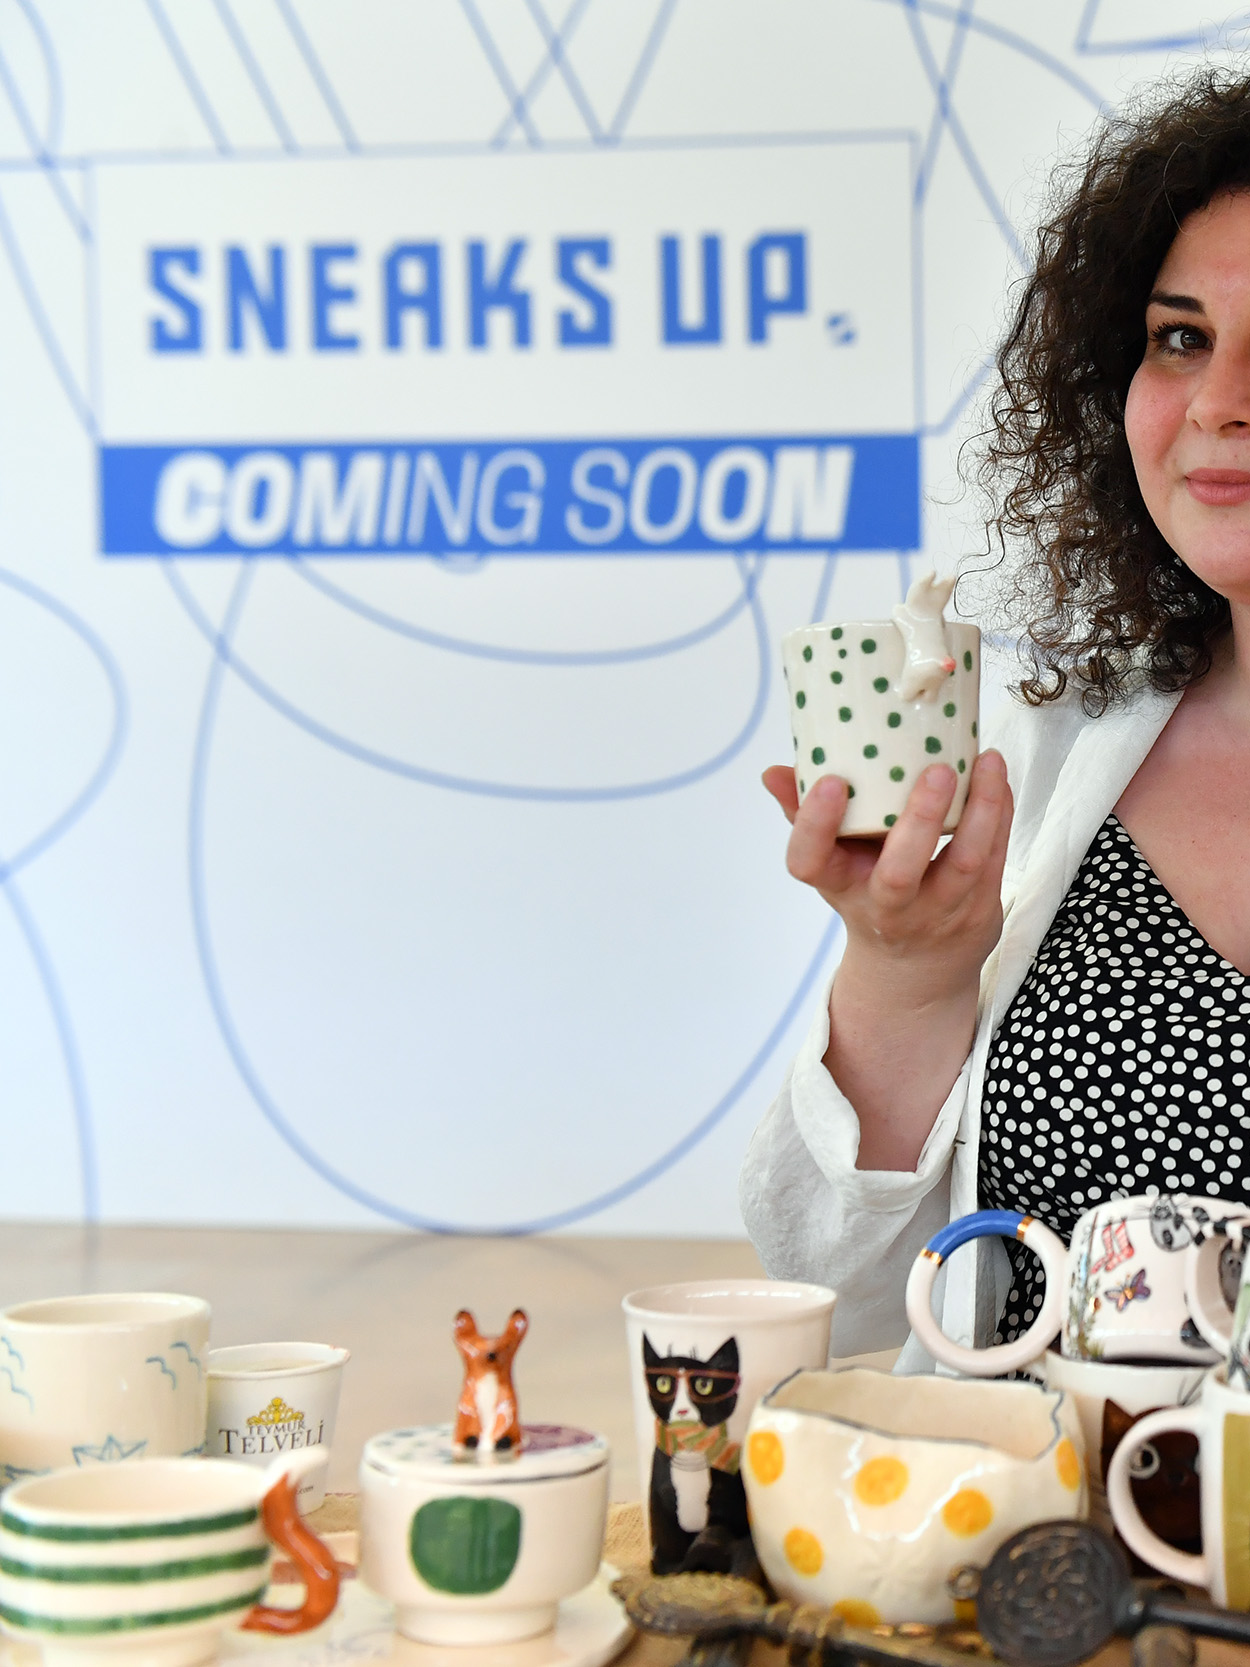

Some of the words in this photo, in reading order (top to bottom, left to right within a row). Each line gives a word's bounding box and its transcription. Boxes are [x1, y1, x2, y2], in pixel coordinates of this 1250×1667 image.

[145, 233, 615, 355] SNEAKS
[153, 448, 546, 548] COMING
[564, 445, 855, 544] SOON
[248, 1420, 306, 1435] TEYMUR
